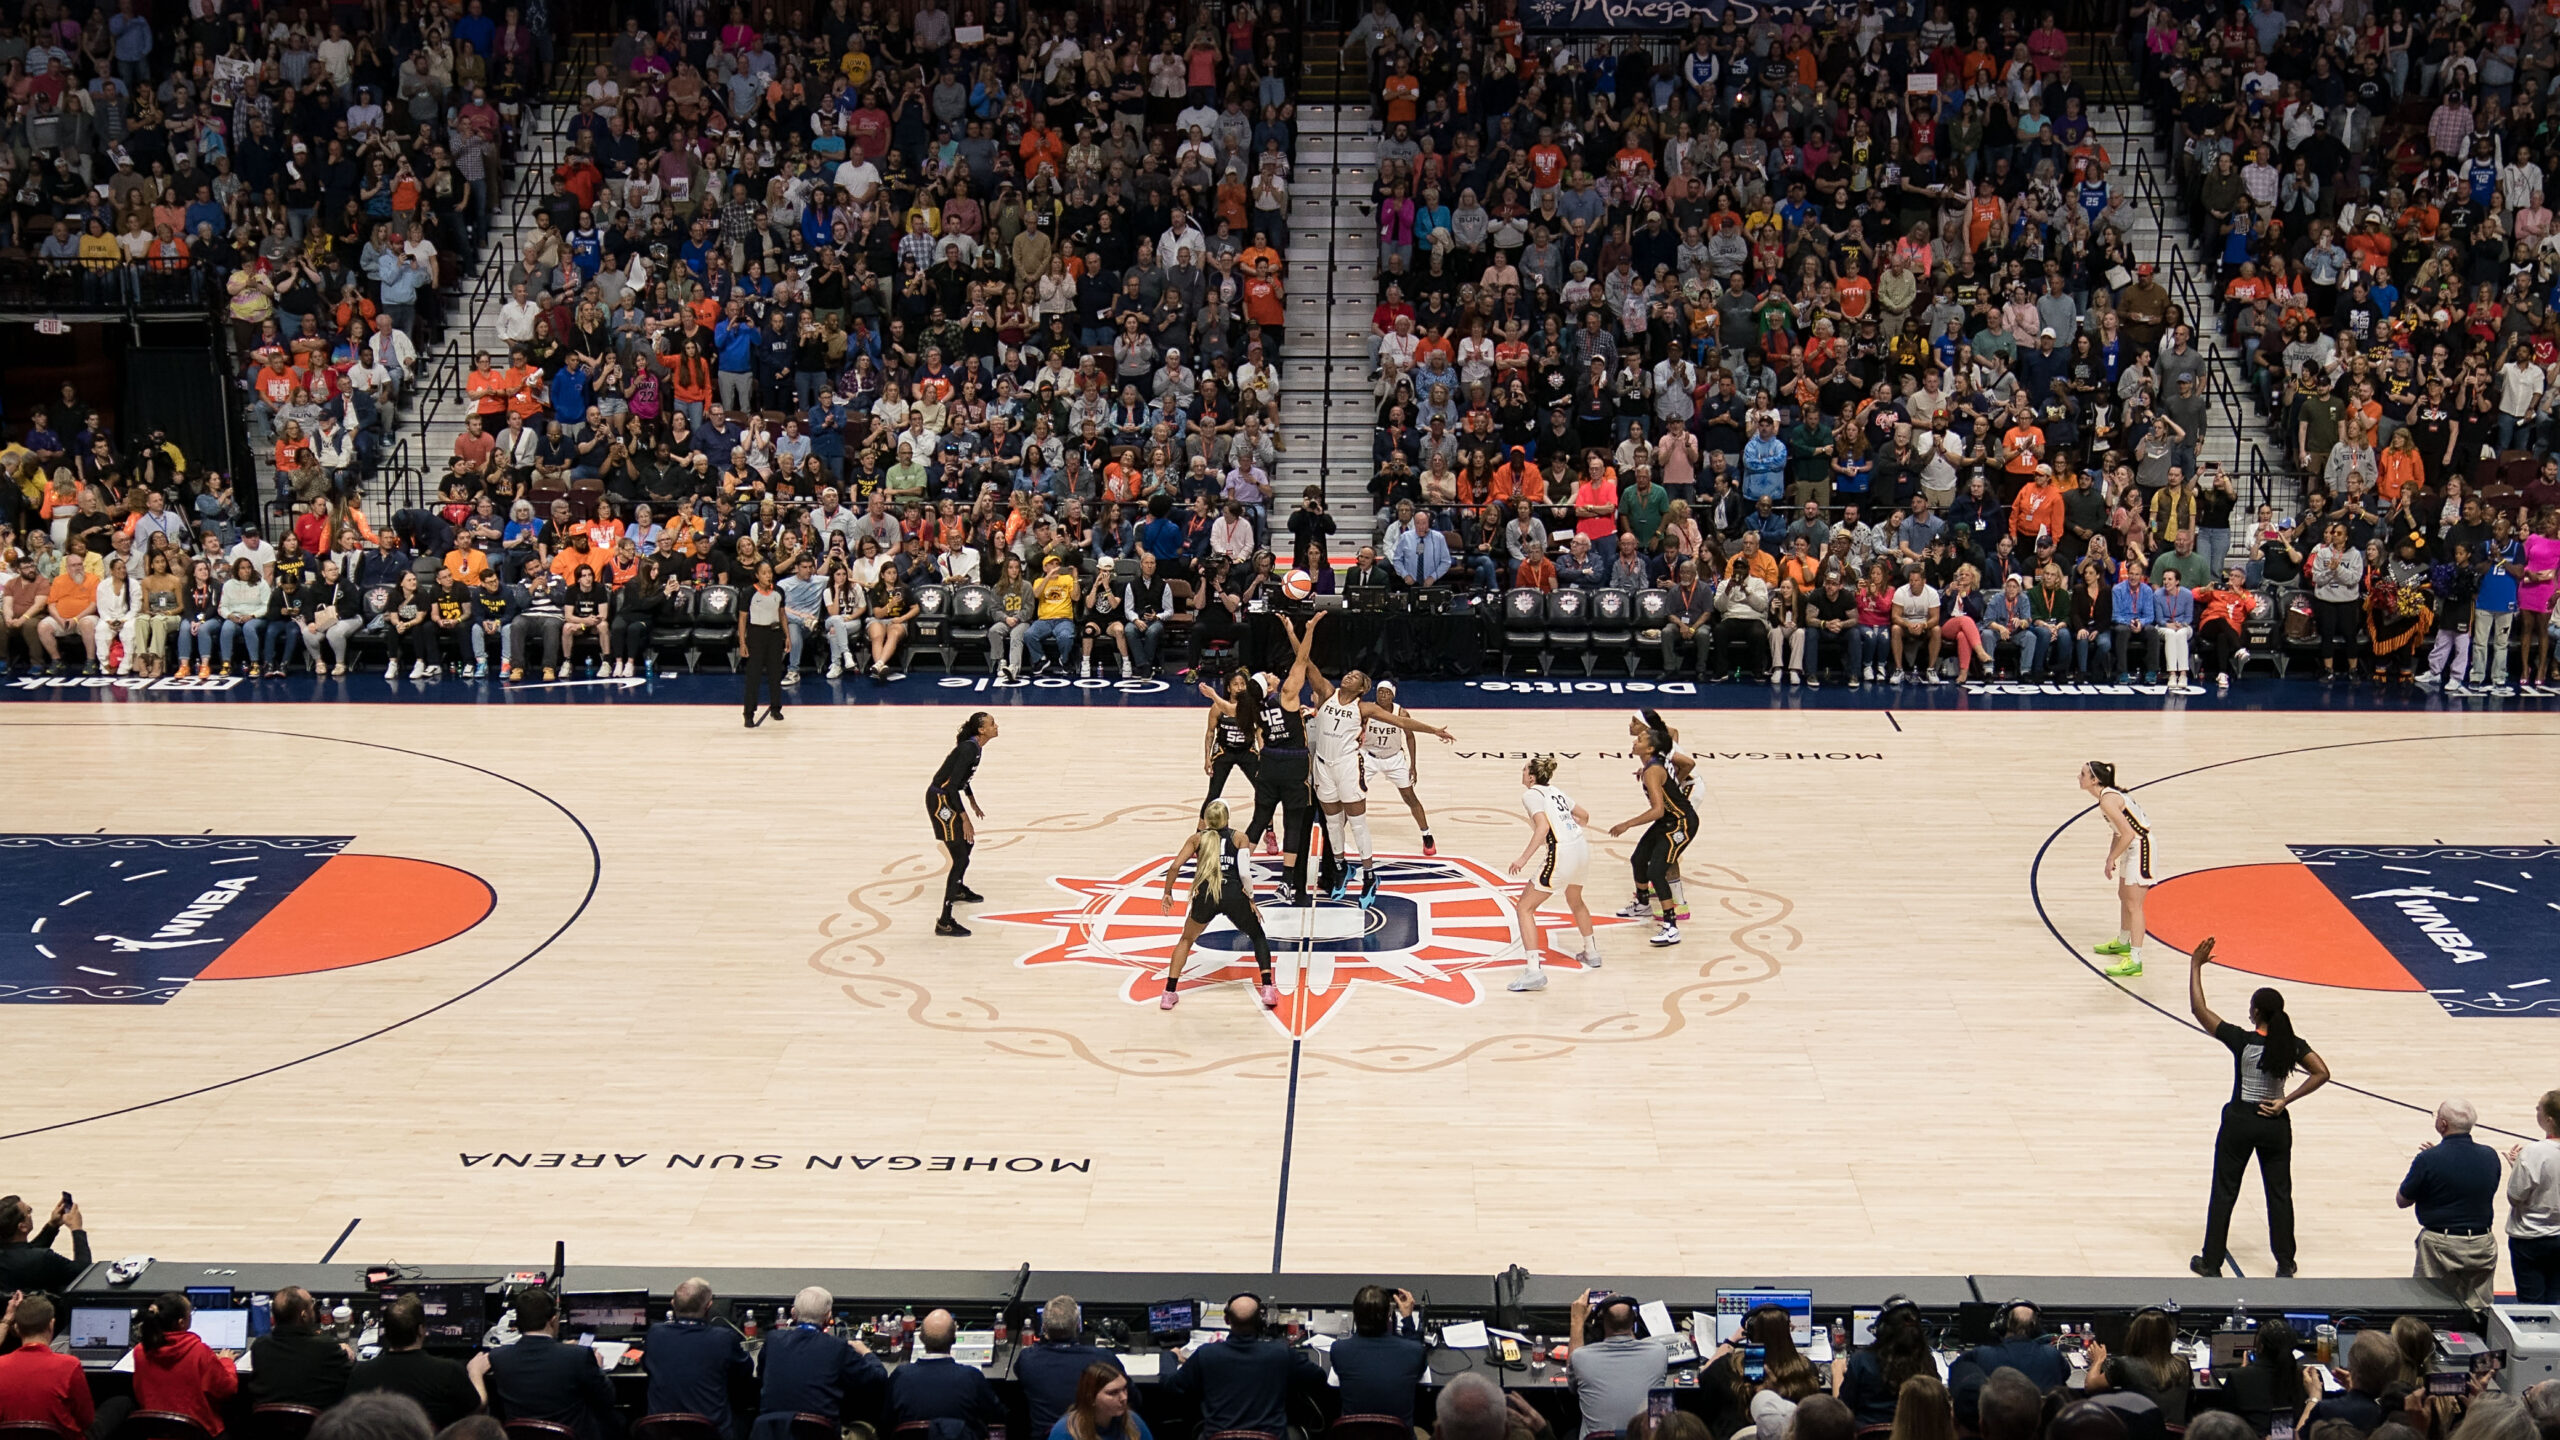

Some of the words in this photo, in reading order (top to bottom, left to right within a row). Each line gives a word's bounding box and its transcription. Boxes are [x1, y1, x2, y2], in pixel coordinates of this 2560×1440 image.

[1570, 0, 1719, 28] Mohegan
[1728, 0, 1793, 24] Sn
[2085, 197, 2099, 206] 25
[1458, 216, 1480, 224] SUN
[43, 320, 60, 333] EXIT
[1899, 354, 1916, 365] 22
[639, 391, 655, 402] 22
[860, 486, 873, 496] 22
[1005, 597, 1022, 611] 22
[442, 608, 461, 620] 22
[8, 677, 152, 690] bank
[938, 678, 1170, 693] Google
[1259, 707, 1285, 727] 42
[1323, 705, 1353, 719] FEVER
[1270, 724, 1286, 734] JONES
[1333, 718, 1341, 731] 7
[1368, 726, 1397, 735] FEVER
[1226, 731, 1246, 743] 52
[1377, 736, 1388, 746] 17
[1455, 751, 1580, 761] ARENA
[1691, 752, 1883, 761] MOHEGAN
[1551, 794, 1569, 812] 33
[151, 876, 259, 939] WNBA
[2394, 899, 2488, 964] WNBA
[459, 1152, 648, 1168] ARENA
[666, 1154, 782, 1170] SUN
[805, 1155, 1090, 1173] MOHEGAN
